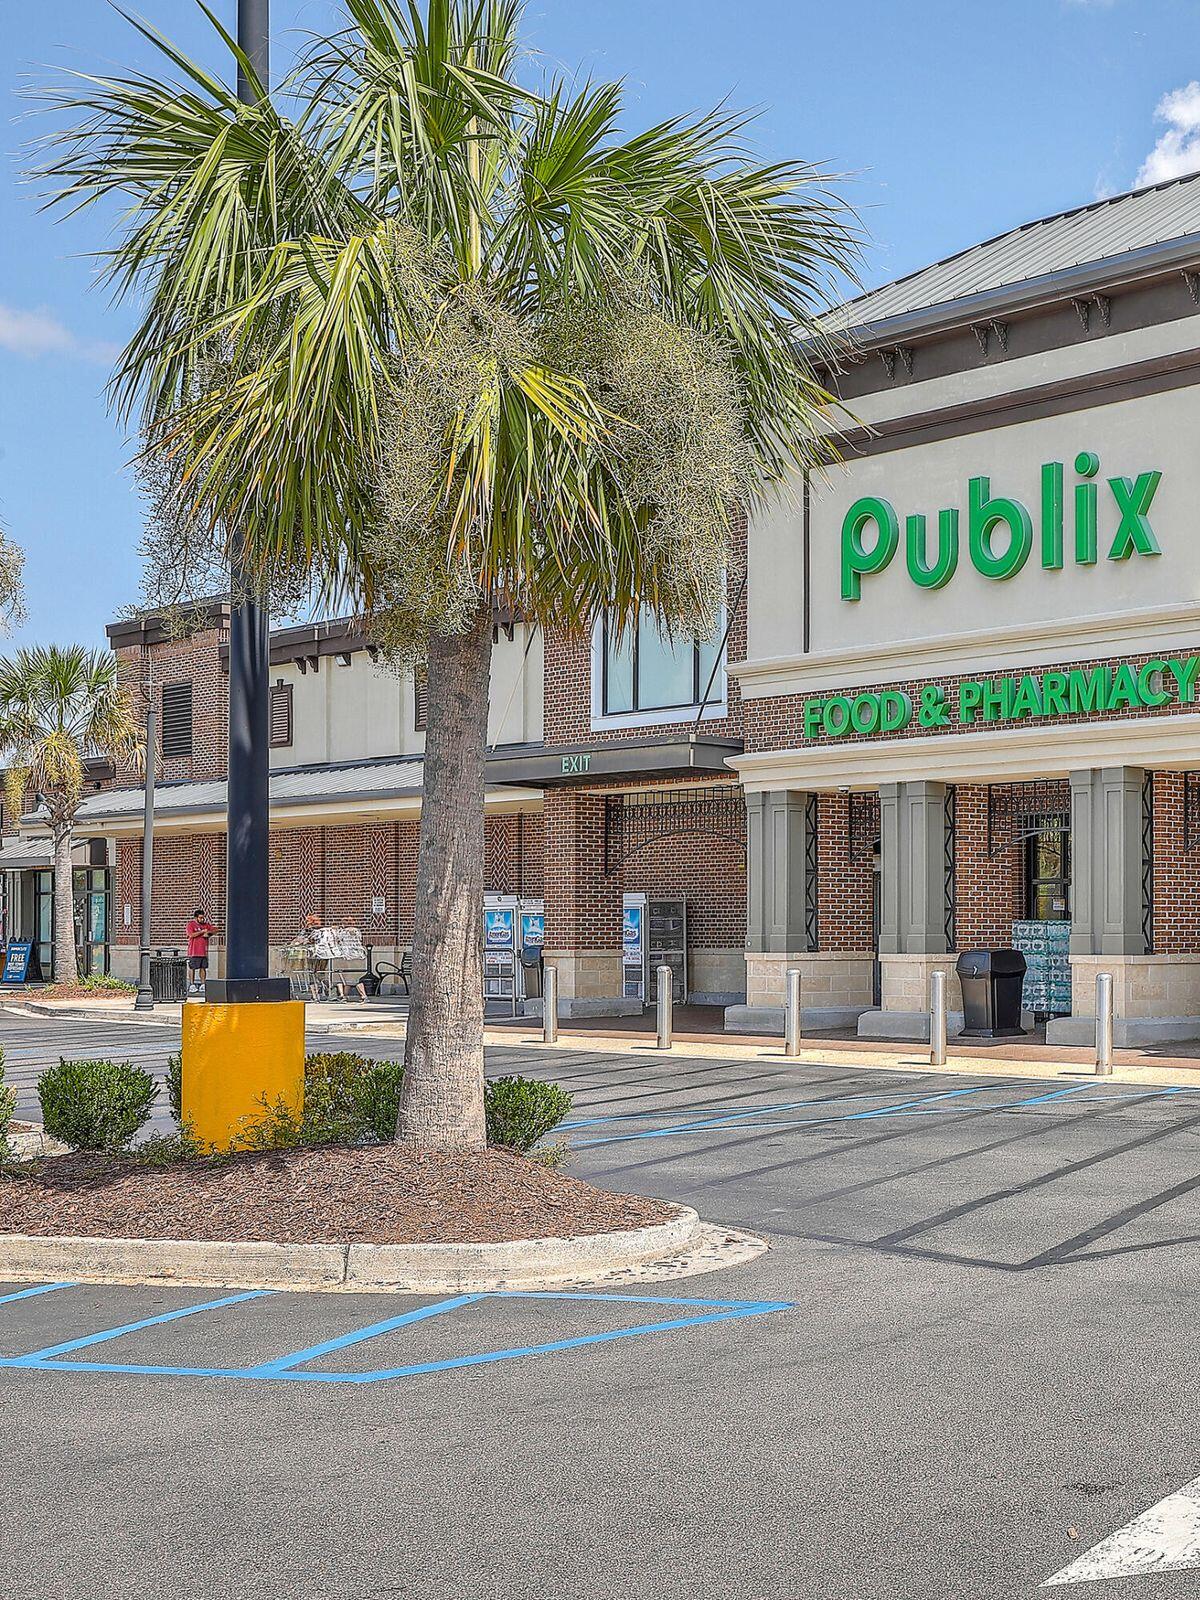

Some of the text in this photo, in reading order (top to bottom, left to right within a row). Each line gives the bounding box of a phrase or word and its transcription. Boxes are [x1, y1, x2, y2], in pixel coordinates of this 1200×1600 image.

[804, 691, 912, 738] FOOD
[919, 685, 951, 727] &
[562, 755, 591, 772] EXIT
[10, 953, 25, 962] FREE
